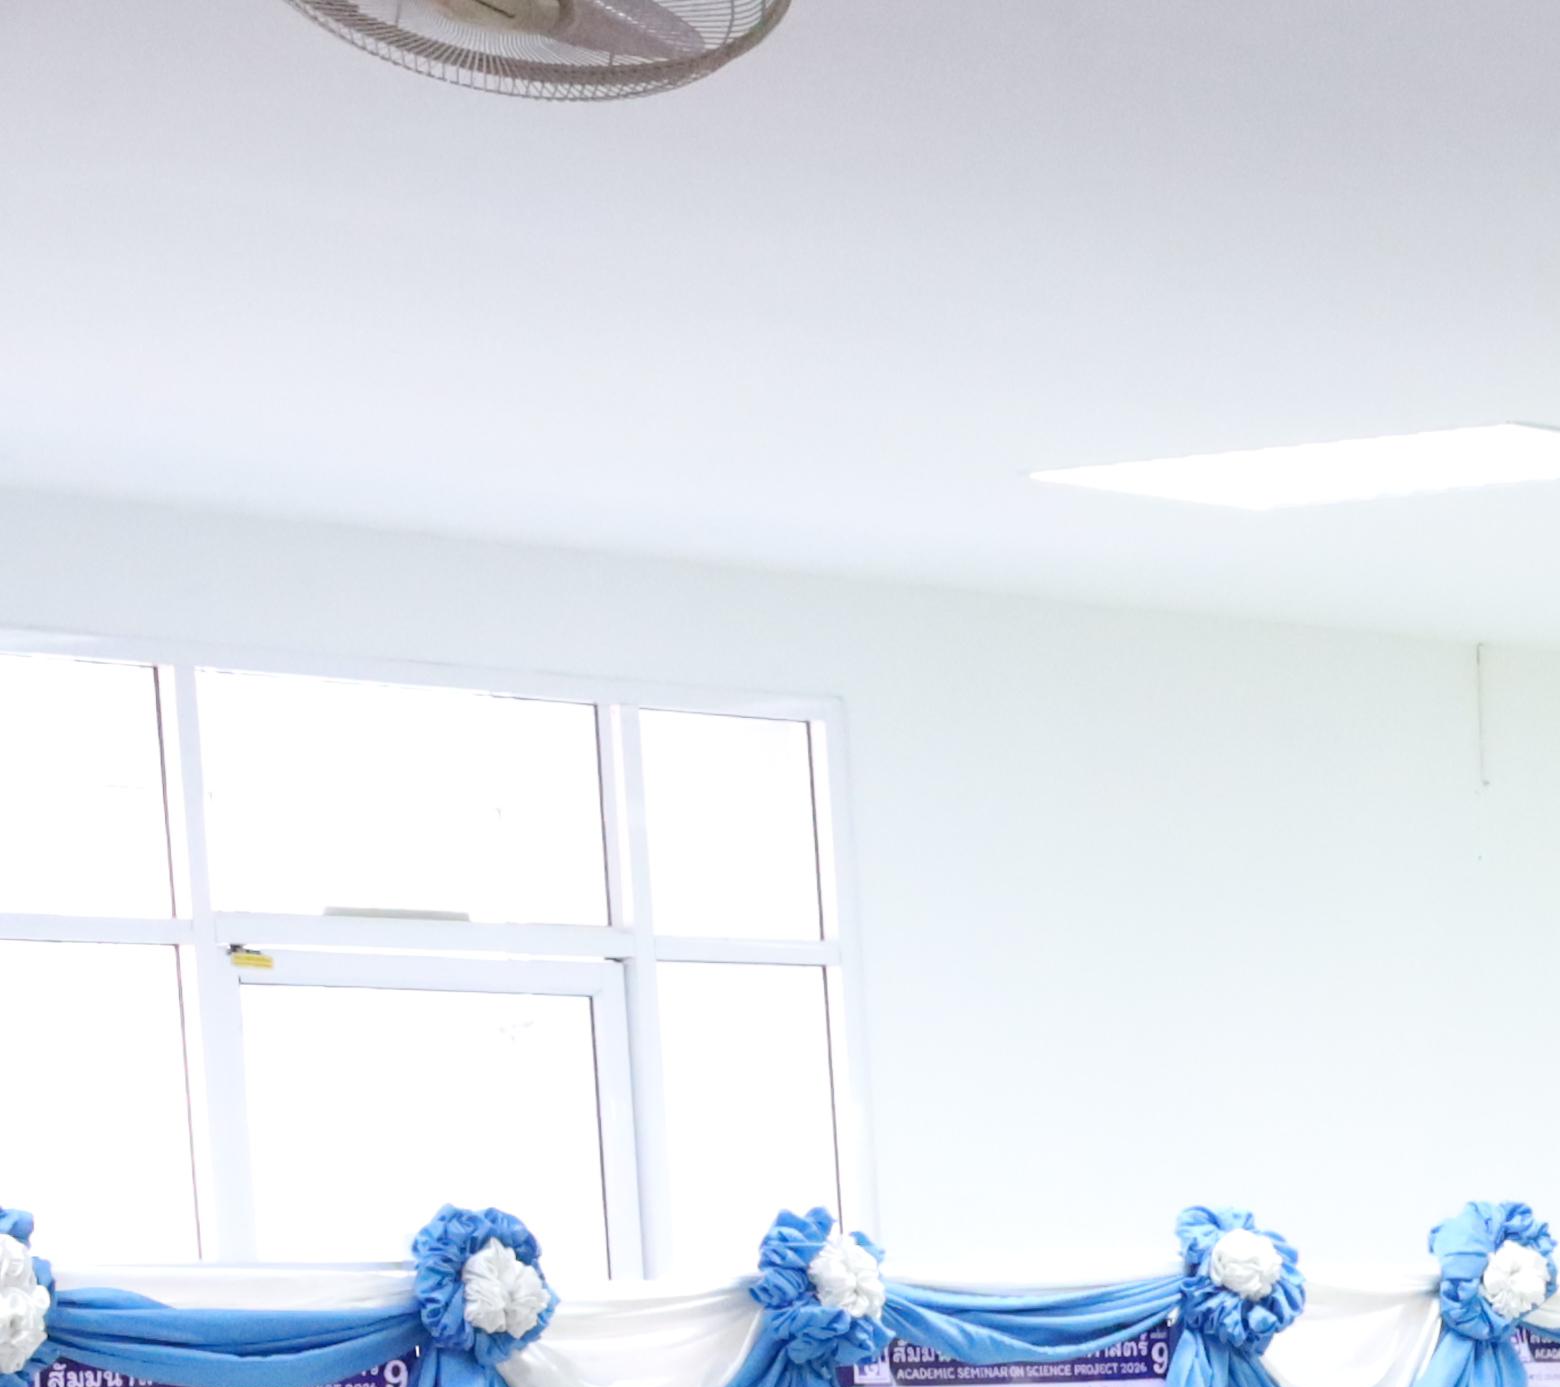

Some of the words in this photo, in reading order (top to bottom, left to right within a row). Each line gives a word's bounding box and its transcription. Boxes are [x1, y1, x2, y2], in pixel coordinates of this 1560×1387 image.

[895, 1367, 956, 1380] ACADEMIC
[957, 1366, 1008, 1379] SEMINAR
[1009, 1366, 1025, 1377] ON
[1026, 1364, 1072, 1377] SCIENCE
[1074, 1362, 1119, 1376] PROJECT
[1120, 1361, 1148, 1374] 2026
[1151, 1341, 1169, 1375] 9
